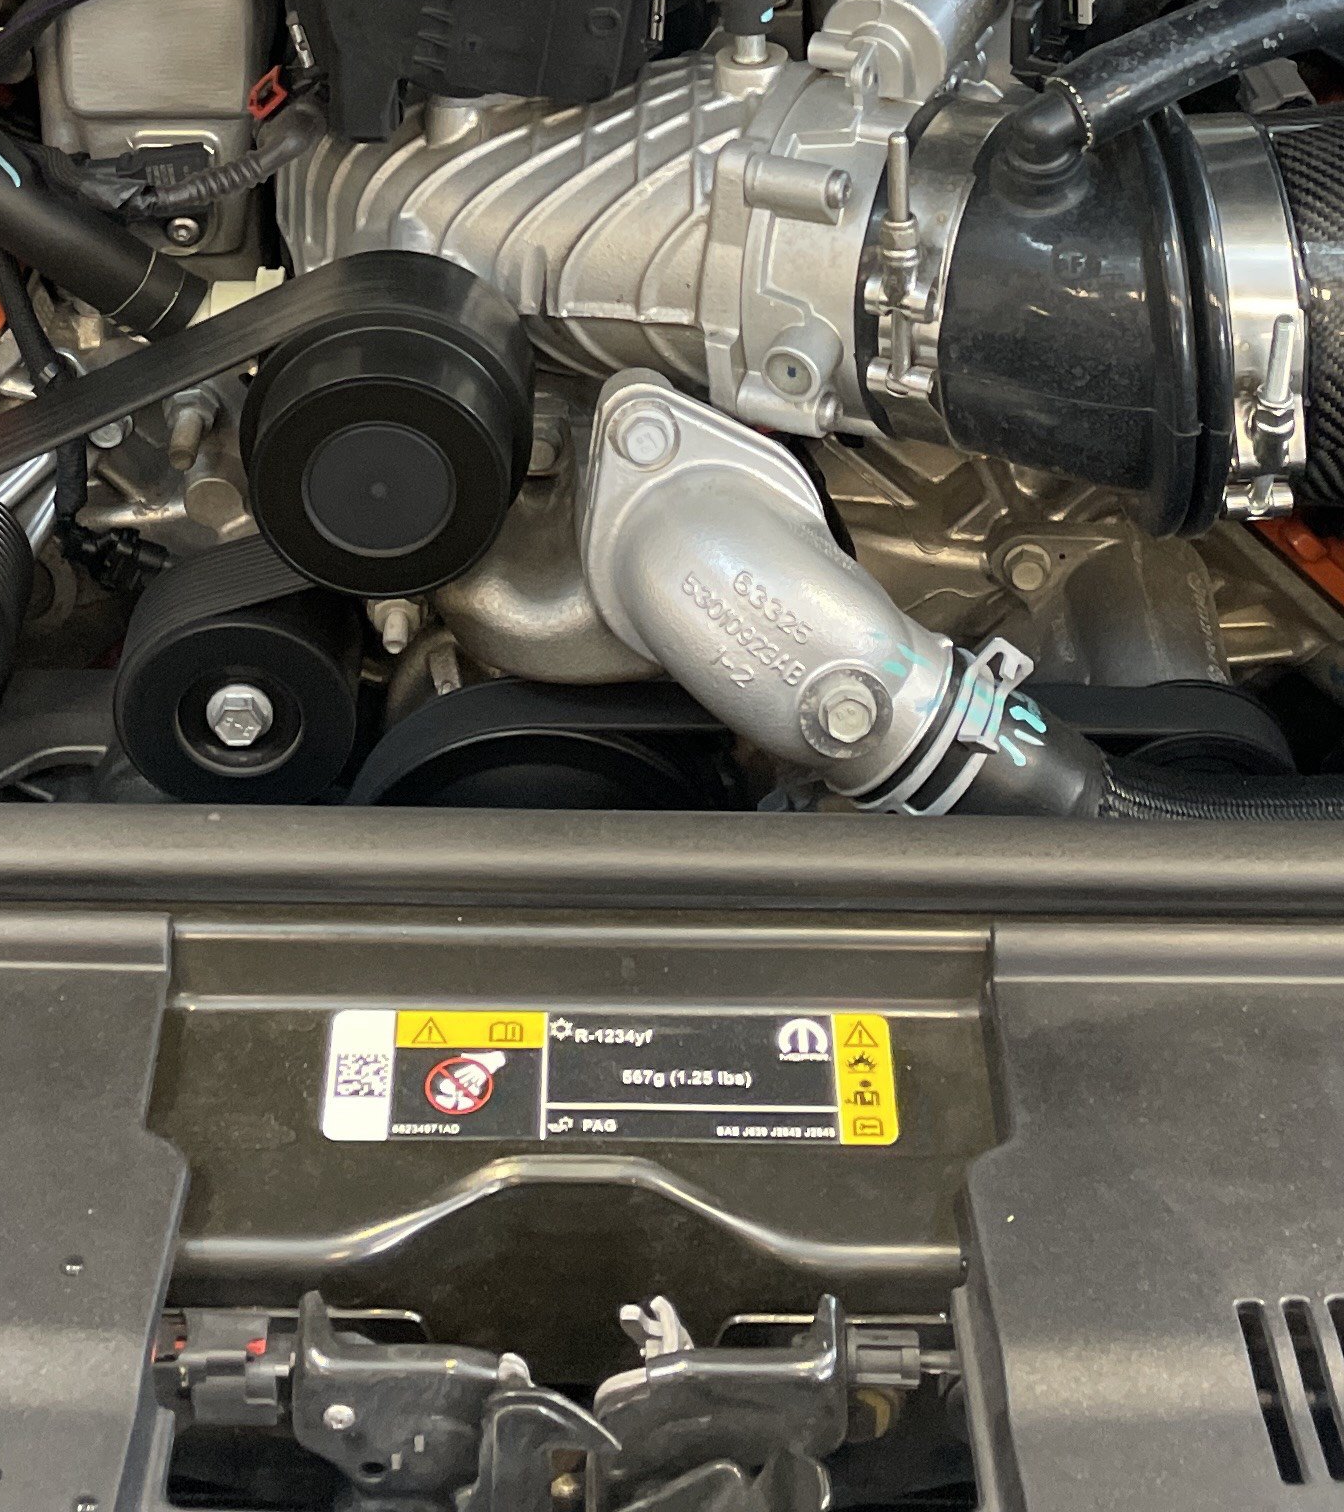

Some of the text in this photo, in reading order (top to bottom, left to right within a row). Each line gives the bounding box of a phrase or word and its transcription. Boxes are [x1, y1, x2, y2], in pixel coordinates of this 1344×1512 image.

[733, 570, 814, 645] 63325
[574, 1028, 653, 1047] R-1234yf
[669, 1069, 714, 1088] (1.25
[582, 1118, 617, 1133] PAG
